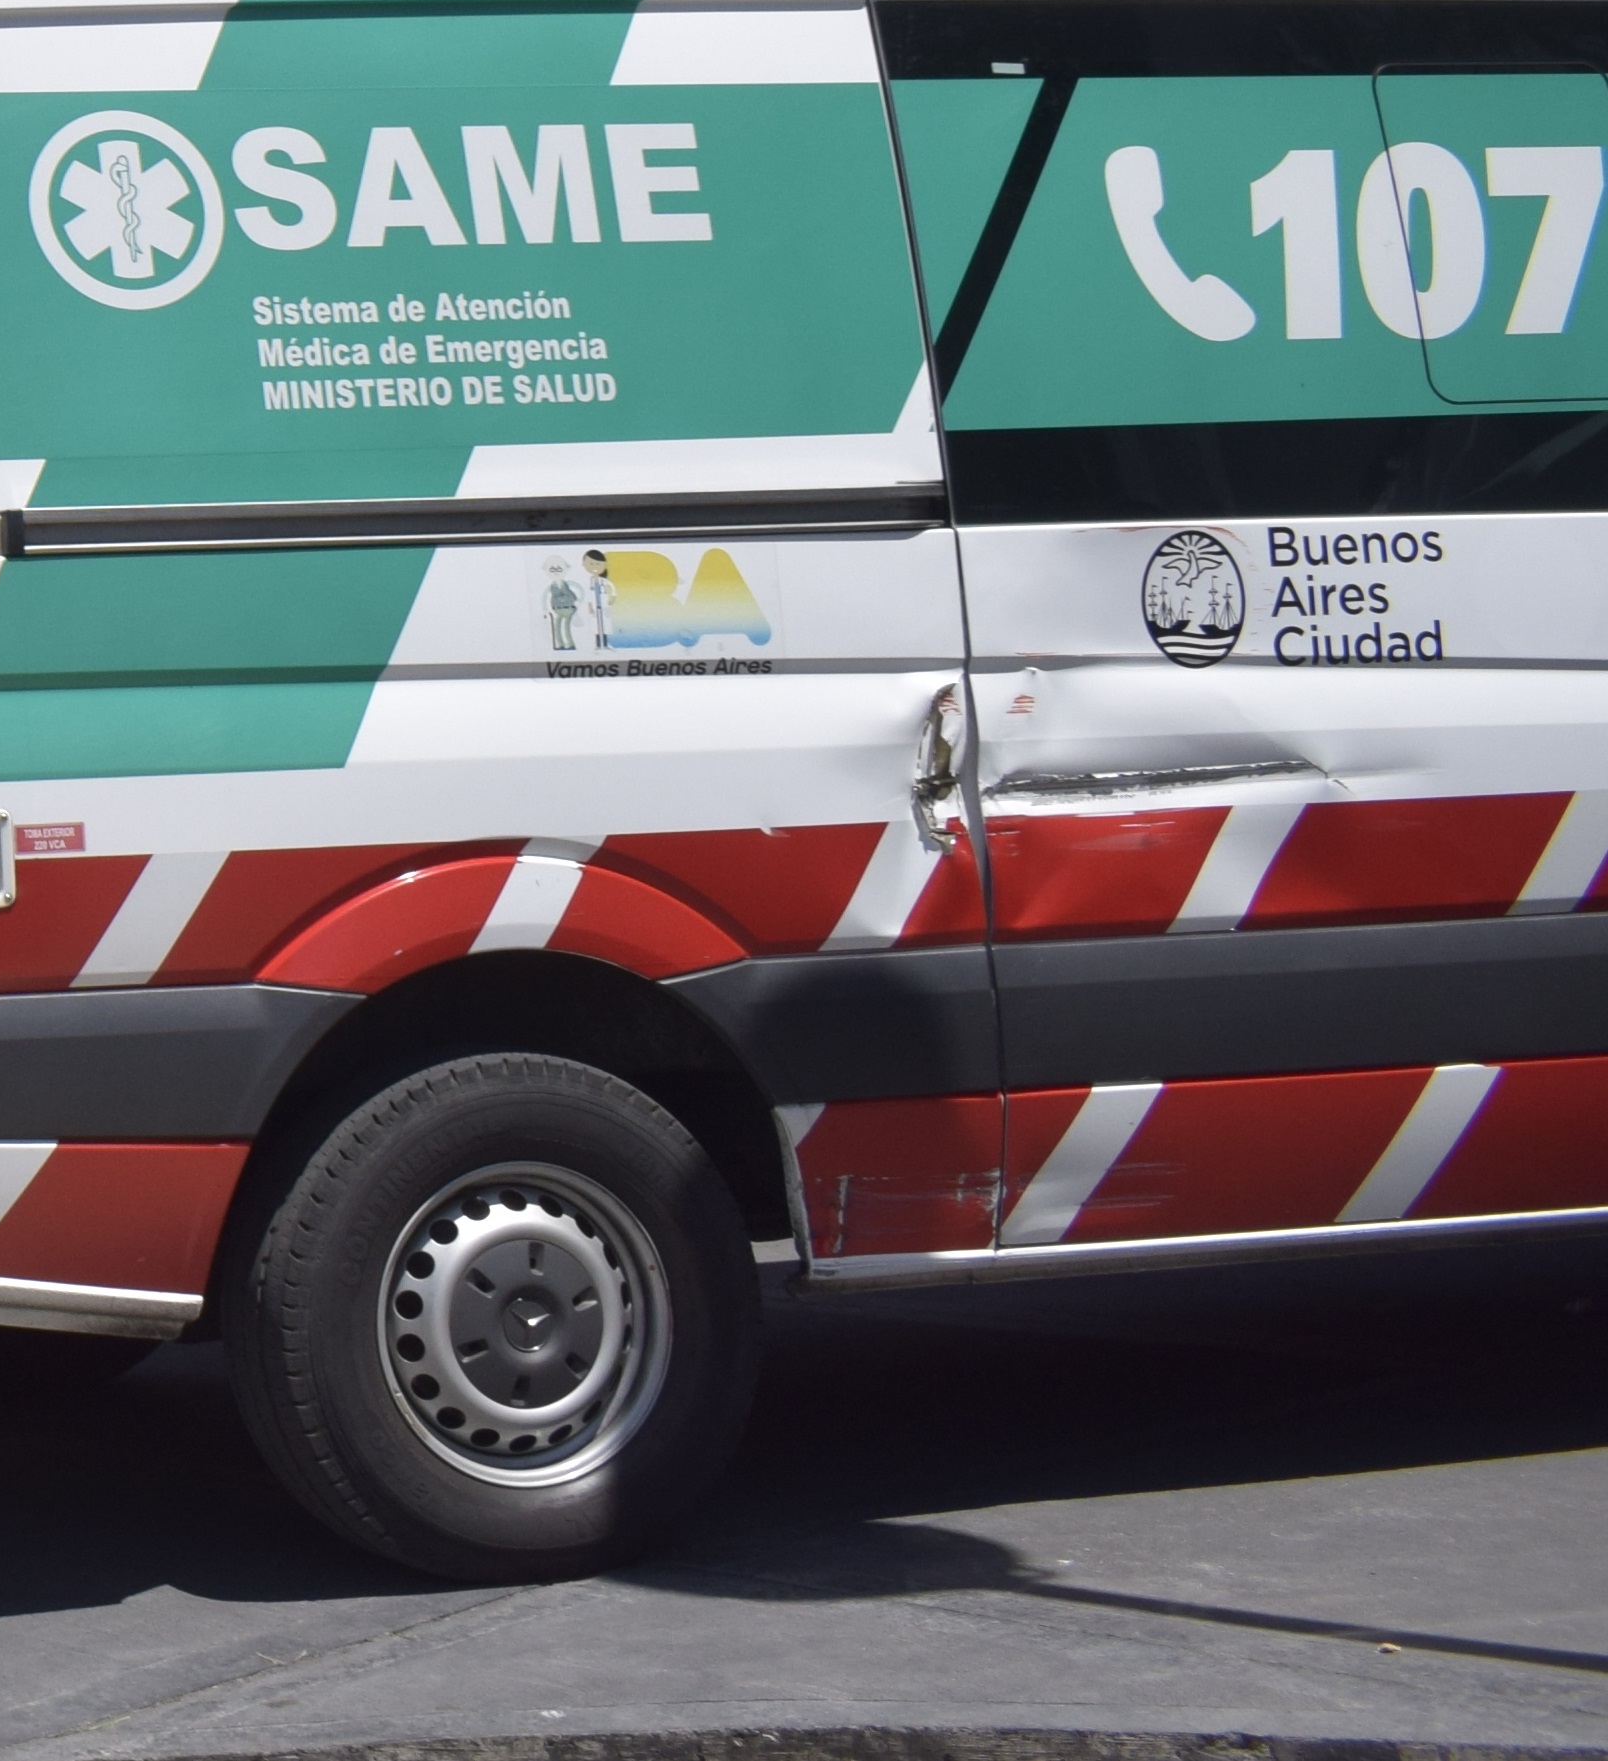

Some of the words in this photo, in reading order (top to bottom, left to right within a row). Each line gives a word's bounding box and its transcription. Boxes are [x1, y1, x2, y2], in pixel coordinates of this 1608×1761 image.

[231, 122, 714, 251] SAME
[1250, 142, 1606, 340] 107
[253, 294, 380, 326] Sistema
[387, 293, 425, 323] de
[435, 290, 571, 322] Atención
[258, 336, 371, 368] Médica
[379, 336, 417, 365] de
[426, 332, 608, 370] Emergencia
[262, 377, 453, 411] MINISTERIO
[463, 376, 504, 406] DE
[513, 373, 617, 405] SALUD
[1267, 526, 1444, 568] Buenos
[1271, 574, 1390, 618] Aires
[1273, 620, 1444, 667] Ciudad
[546, 660, 620, 679] Vamos
[627, 659, 707, 678] Buenos
[713, 657, 772, 675] Aires
